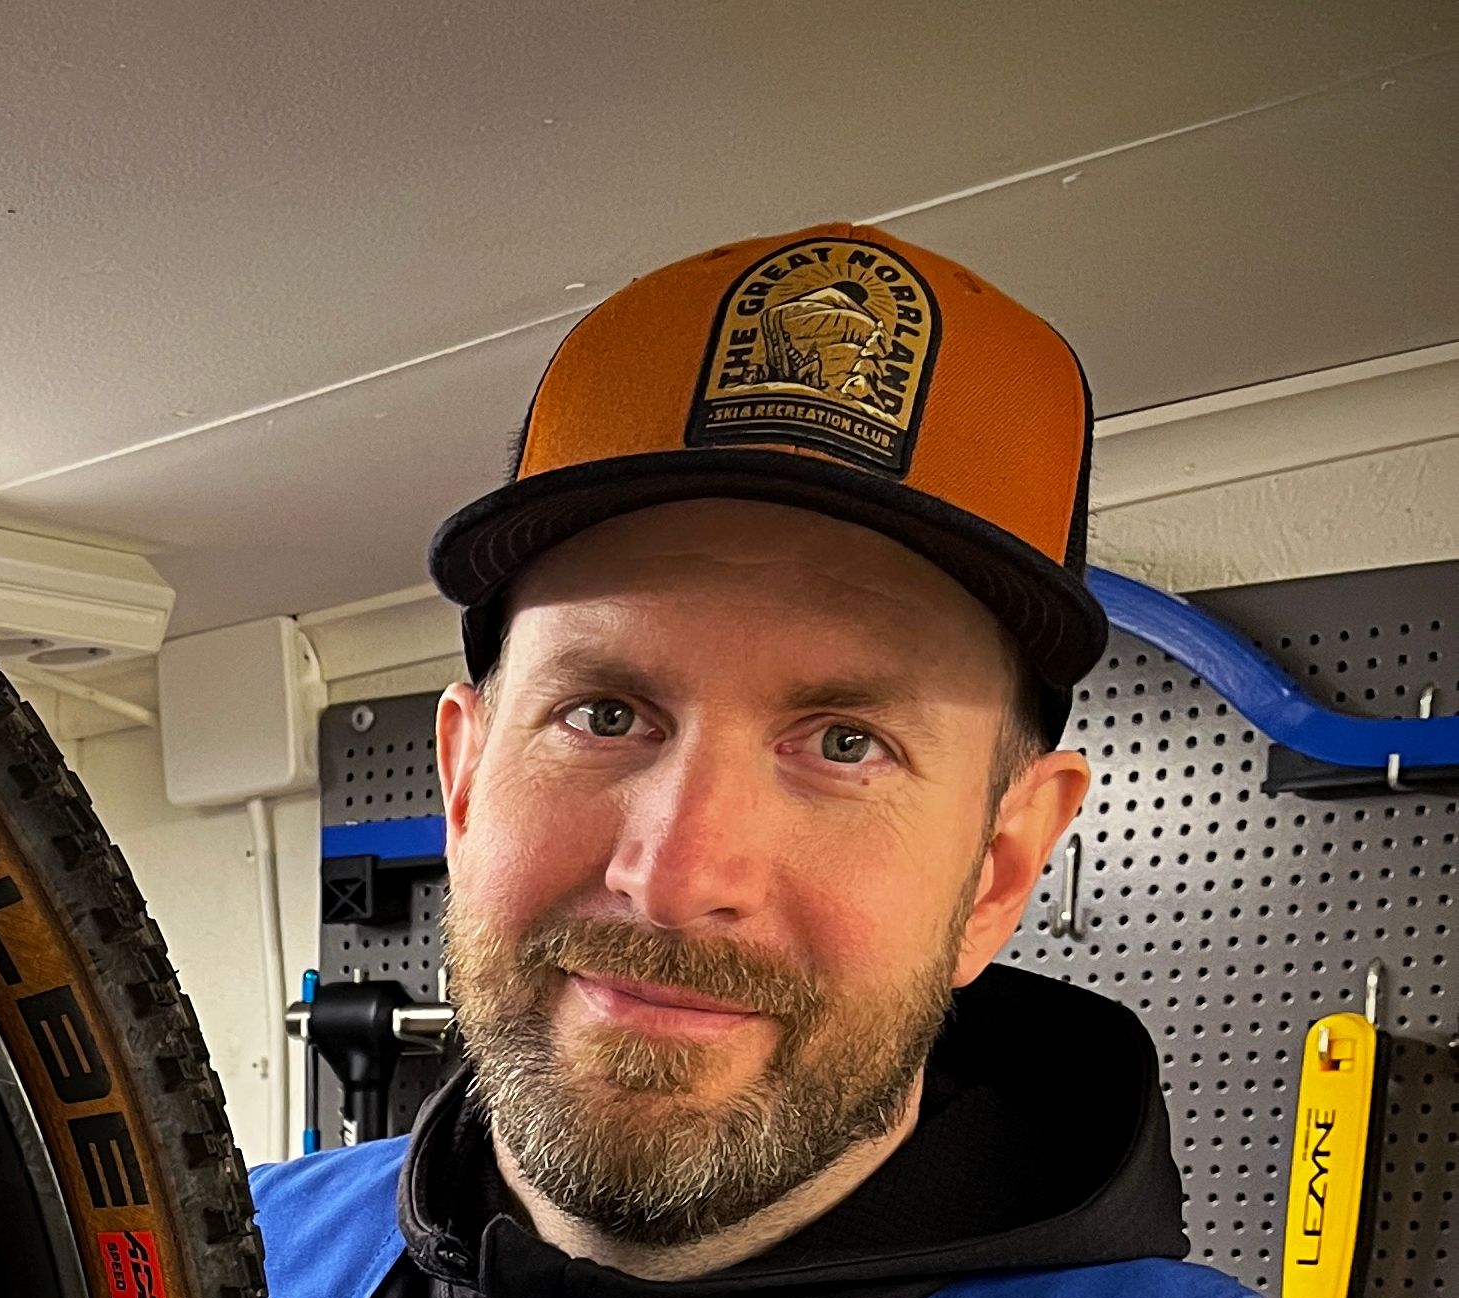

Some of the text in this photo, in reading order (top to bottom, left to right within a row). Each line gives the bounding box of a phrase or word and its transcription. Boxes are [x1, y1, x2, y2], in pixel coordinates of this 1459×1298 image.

[718, 247, 923, 416] THE GREAT NORRLAND
[713, 404, 738, 421] SKI
[754, 404, 851, 432] RECREATION
[853, 423, 891, 448] CLUB
[1297, 1108, 1336, 1265] LEZYNE
[107, 1242, 126, 1291] SPEED
